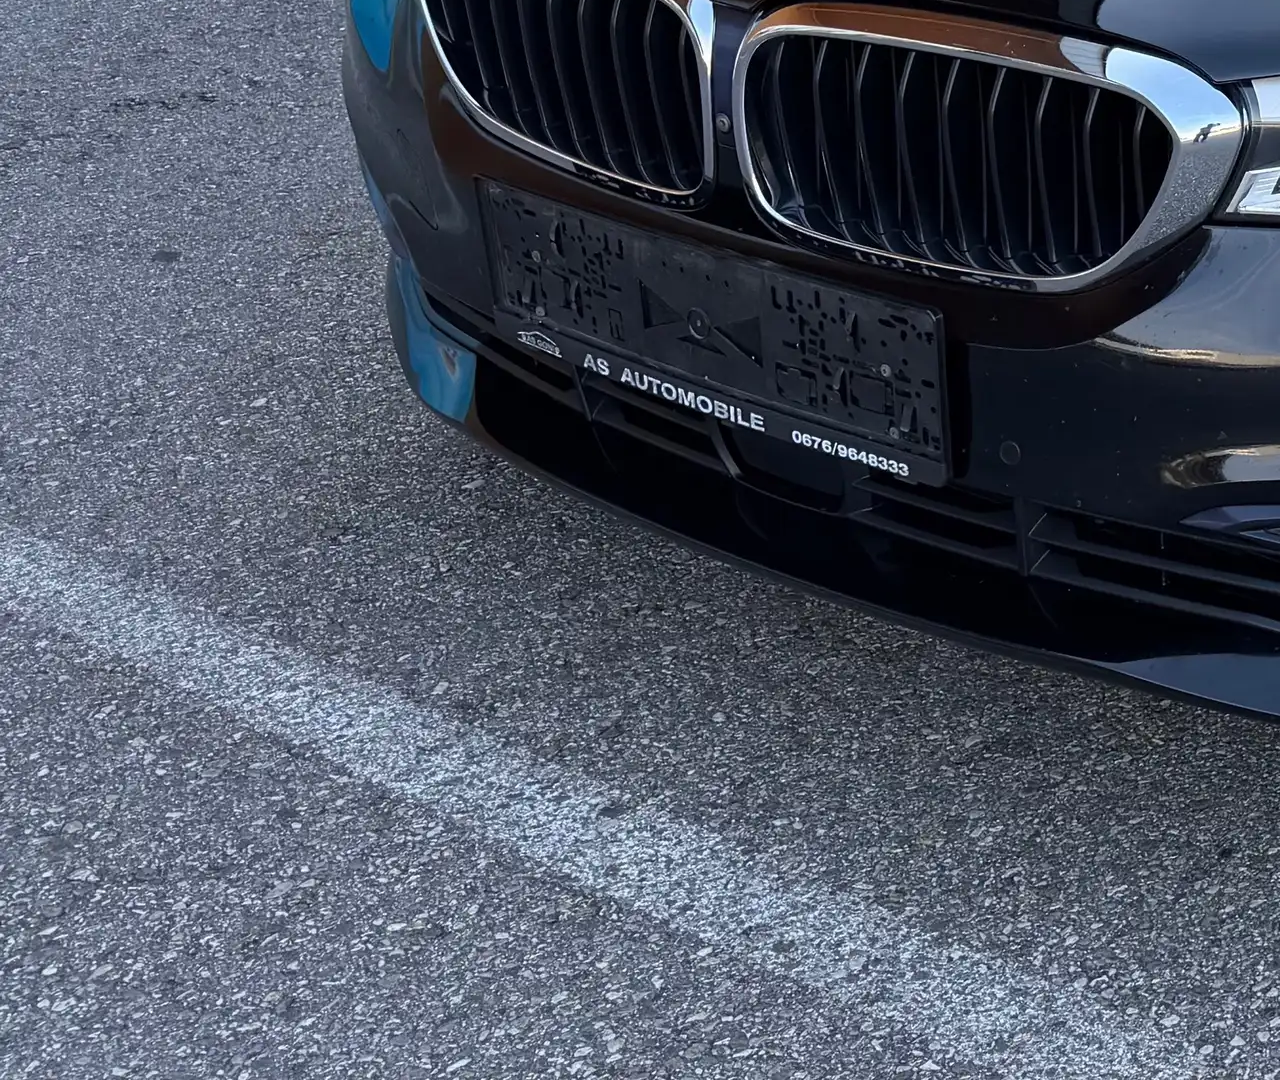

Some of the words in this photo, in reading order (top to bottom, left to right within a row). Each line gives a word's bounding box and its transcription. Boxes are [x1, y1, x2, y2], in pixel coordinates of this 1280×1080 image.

[583, 353, 610, 376] AS
[620, 367, 766, 432] AUTOMOBILE
[791, 430, 910, 477] 0676/9648333
